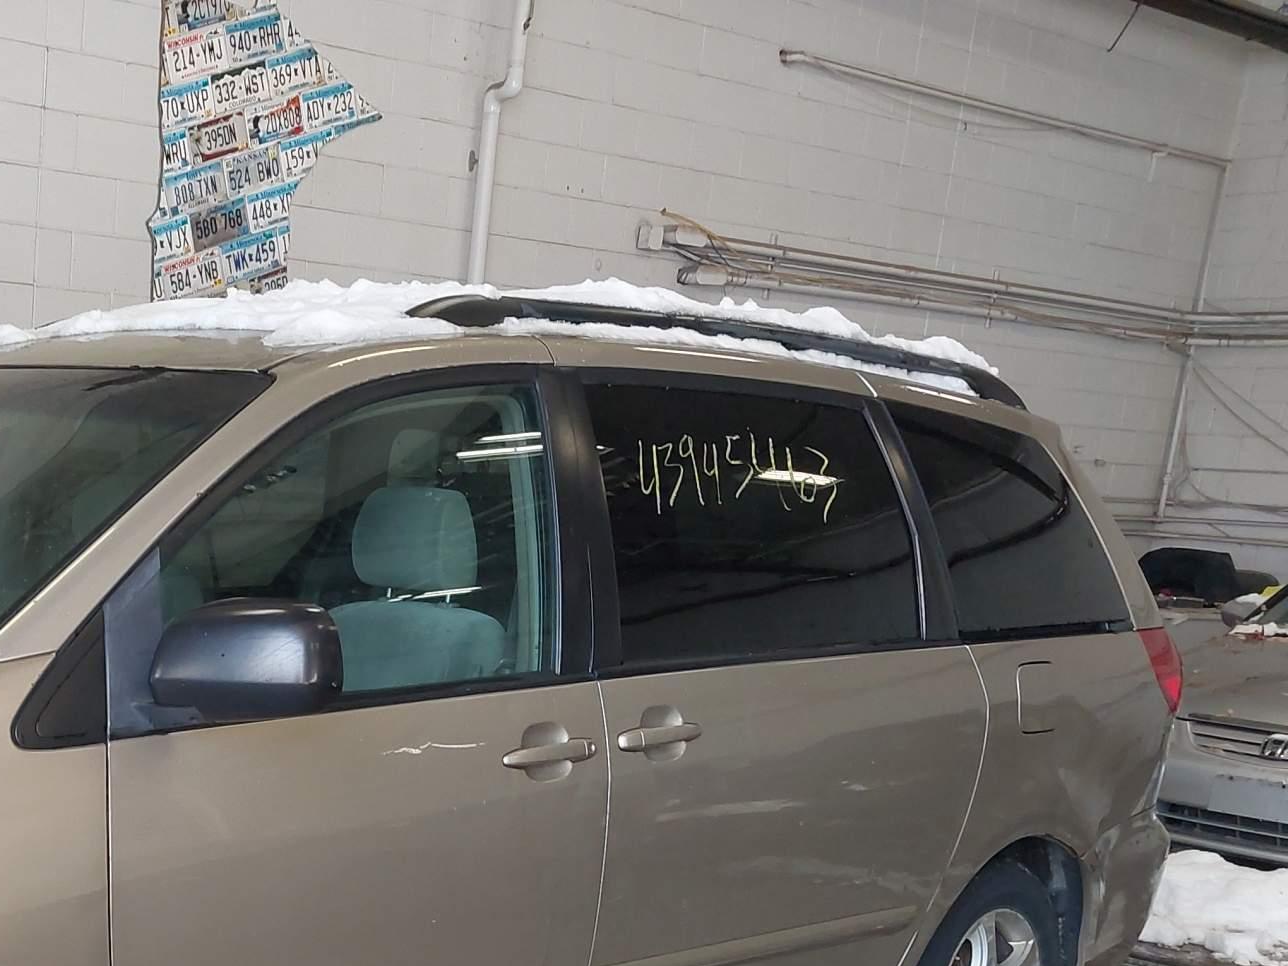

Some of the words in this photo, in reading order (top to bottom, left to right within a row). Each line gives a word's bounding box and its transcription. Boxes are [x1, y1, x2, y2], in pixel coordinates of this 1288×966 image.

[333, 91, 354, 115] 232
[229, 166, 251, 191] 524
[221, 208, 243, 230] 768
[255, 240, 276, 265] 459
[638, 432, 838, 524] 43945463
